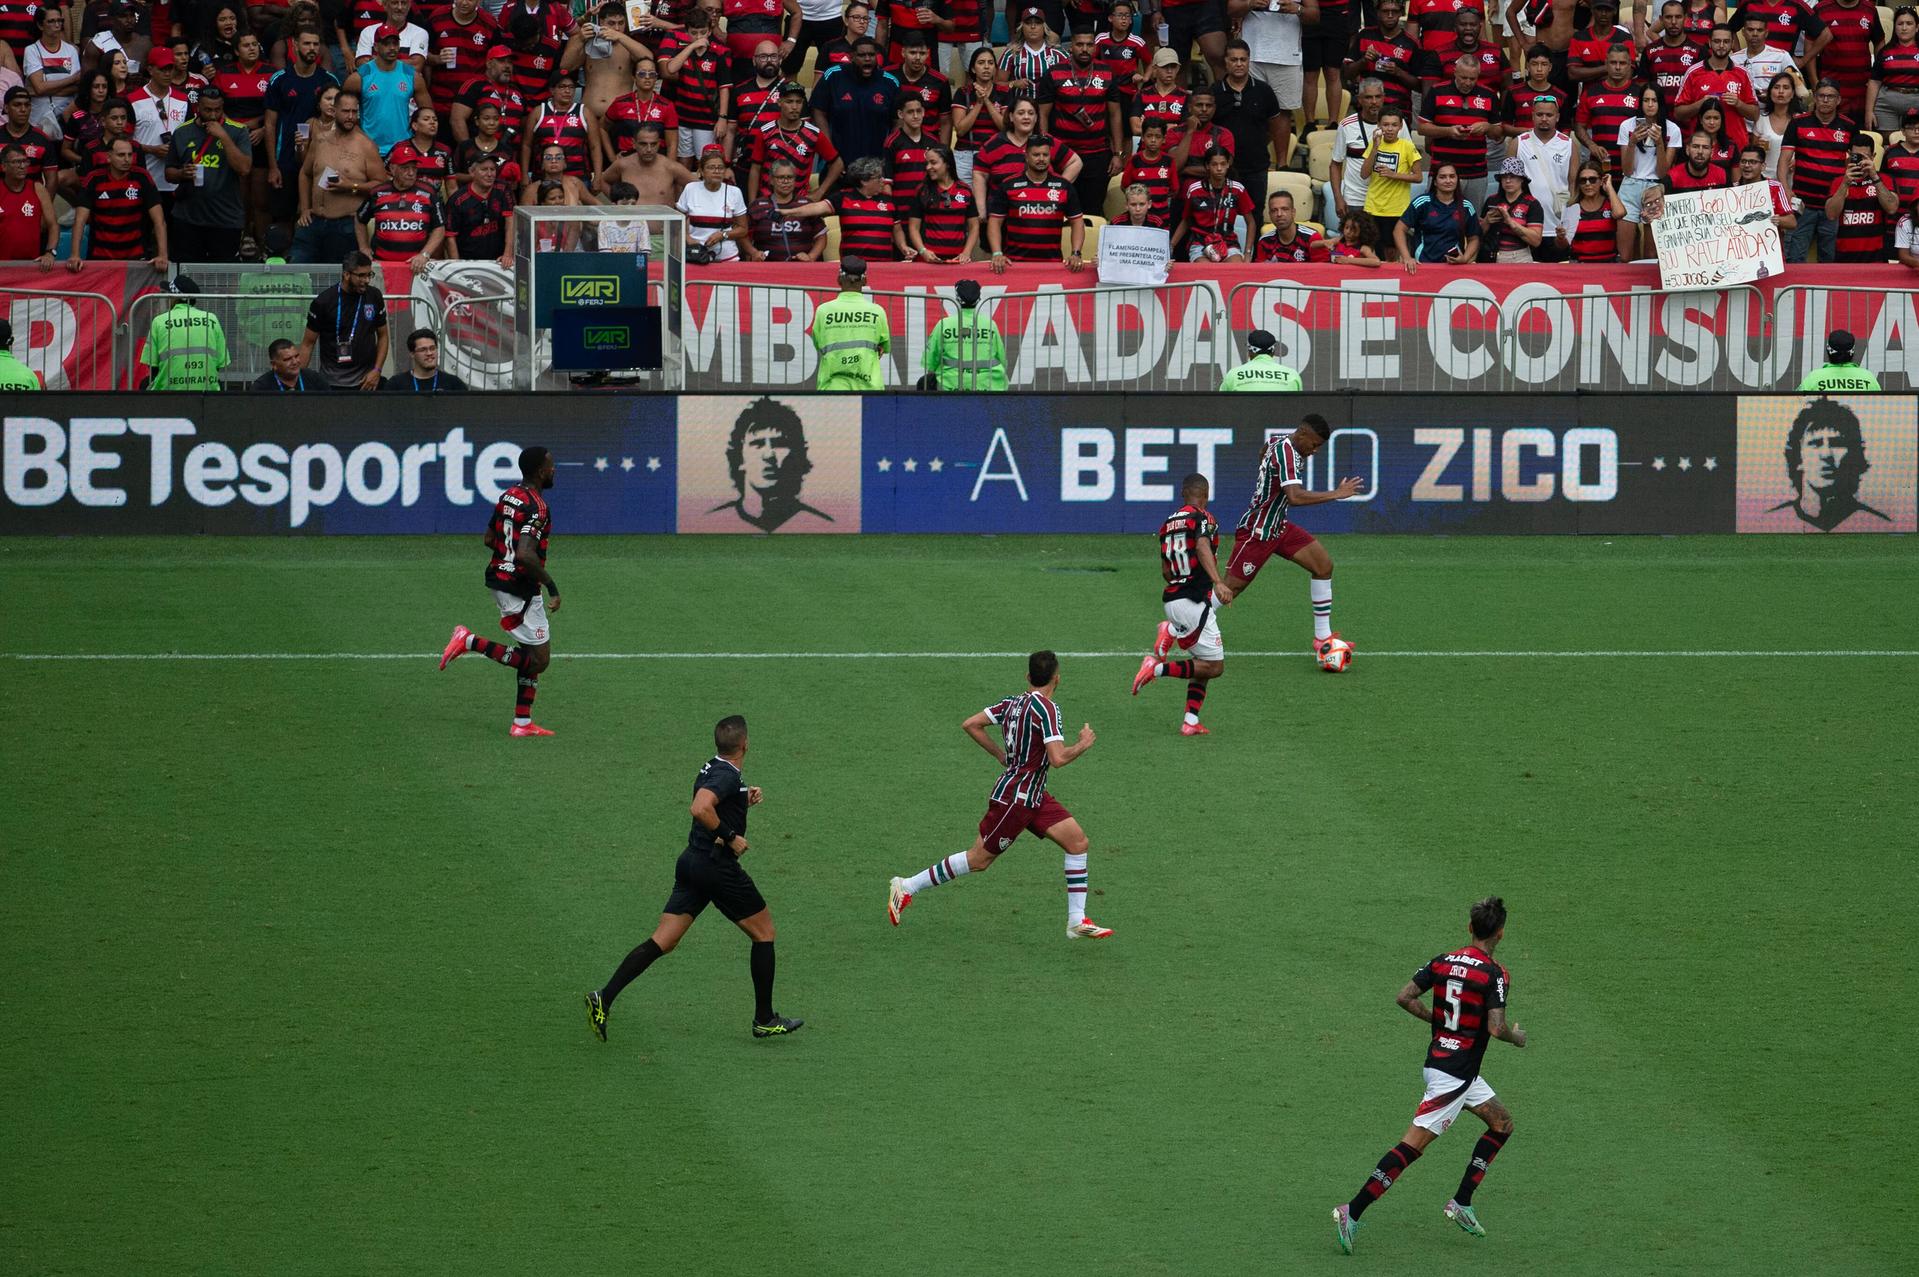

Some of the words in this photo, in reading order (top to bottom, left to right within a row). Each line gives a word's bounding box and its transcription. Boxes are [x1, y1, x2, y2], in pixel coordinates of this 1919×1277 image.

[1725, 185, 1767, 214] Ortiz
[1019, 204, 1058, 217] pixbet
[1674, 217, 1689, 230] QUE
[1852, 212, 1875, 225] BRB
[1694, 228, 1712, 241] SUA
[1714, 224, 1749, 238] CAMISA
[1685, 239, 1725, 269] RAIZ
[1682, 270, 1710, 287] JOGOS
[566, 281, 614, 297] VAR
[165, 317, 217, 330] SUNSET
[826, 311, 879, 325] SUNSET
[587, 330, 625, 343] VAR
[1340, 279, 1400, 379] E
[9, 298, 76, 390] R
[185, 361, 204, 369] 693
[841, 355, 861, 365] 828
[1237, 370, 1290, 381] SUNSET
[0, 383, 30, 391] SET
[1818, 379, 1871, 391] SUNSET
[970, 427, 1029, 501] A
[1060, 428, 1233, 501] BET
[1411, 428, 1619, 501] ZICO
[3, 417, 525, 527] BETesporte
[1165, 532, 1191, 576] 18
[1443, 979, 1464, 1031] 5
